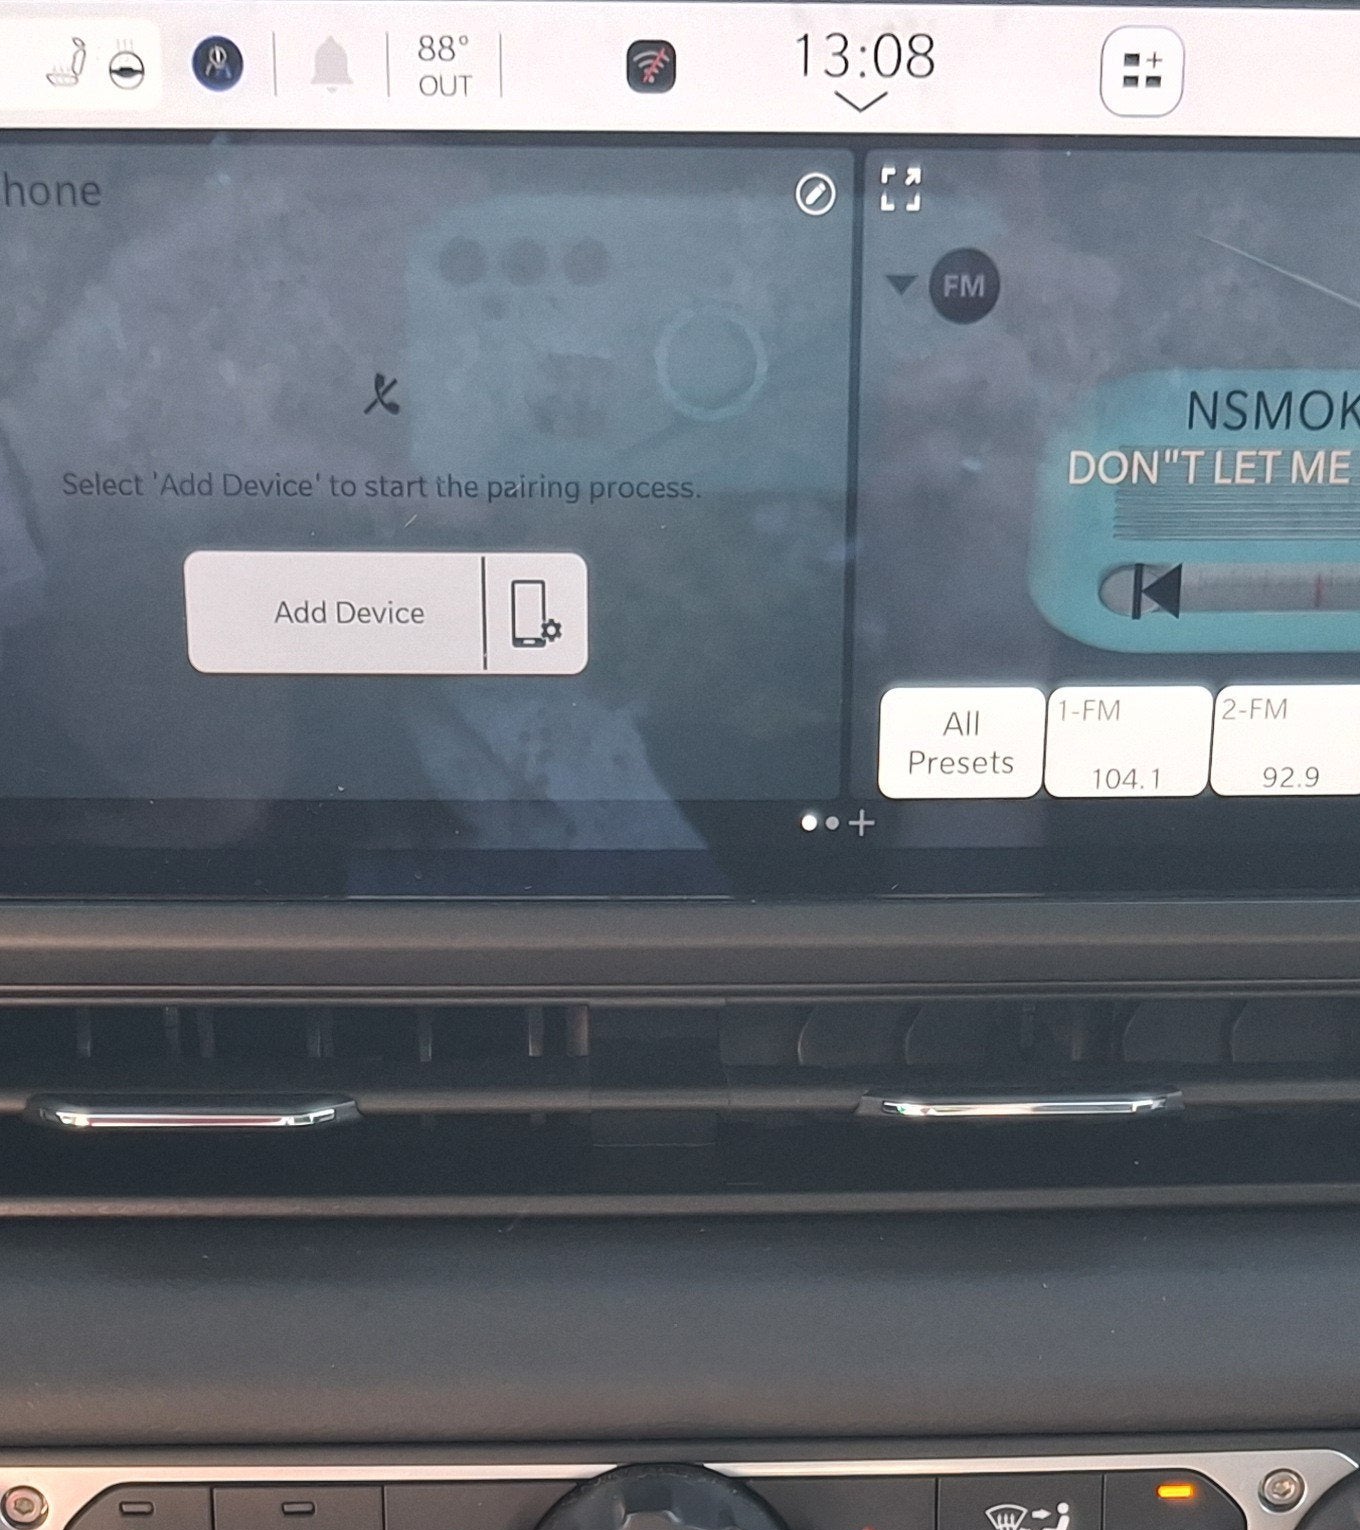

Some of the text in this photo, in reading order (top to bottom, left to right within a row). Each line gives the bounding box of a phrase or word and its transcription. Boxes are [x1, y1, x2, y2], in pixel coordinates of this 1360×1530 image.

[418, 35, 469, 62] 88°
[796, 31, 936, 79] 13:08
[418, 75, 473, 97] OUT
[943, 275, 986, 298] FM
[1214, 450, 1280, 485] LET
[1290, 450, 1351, 485] ME
[62, 471, 702, 505] Select 'Add Device' to start the pairing process.
[274, 600, 425, 626] Add Device
[1058, 699, 1121, 722] 1-FM
[1222, 698, 1289, 720] 2-FM
[943, 711, 980, 737] All
[908, 750, 1015, 777] Presets
[1093, 768, 1161, 791] 104.1
[1262, 766, 1320, 789] 92.9
